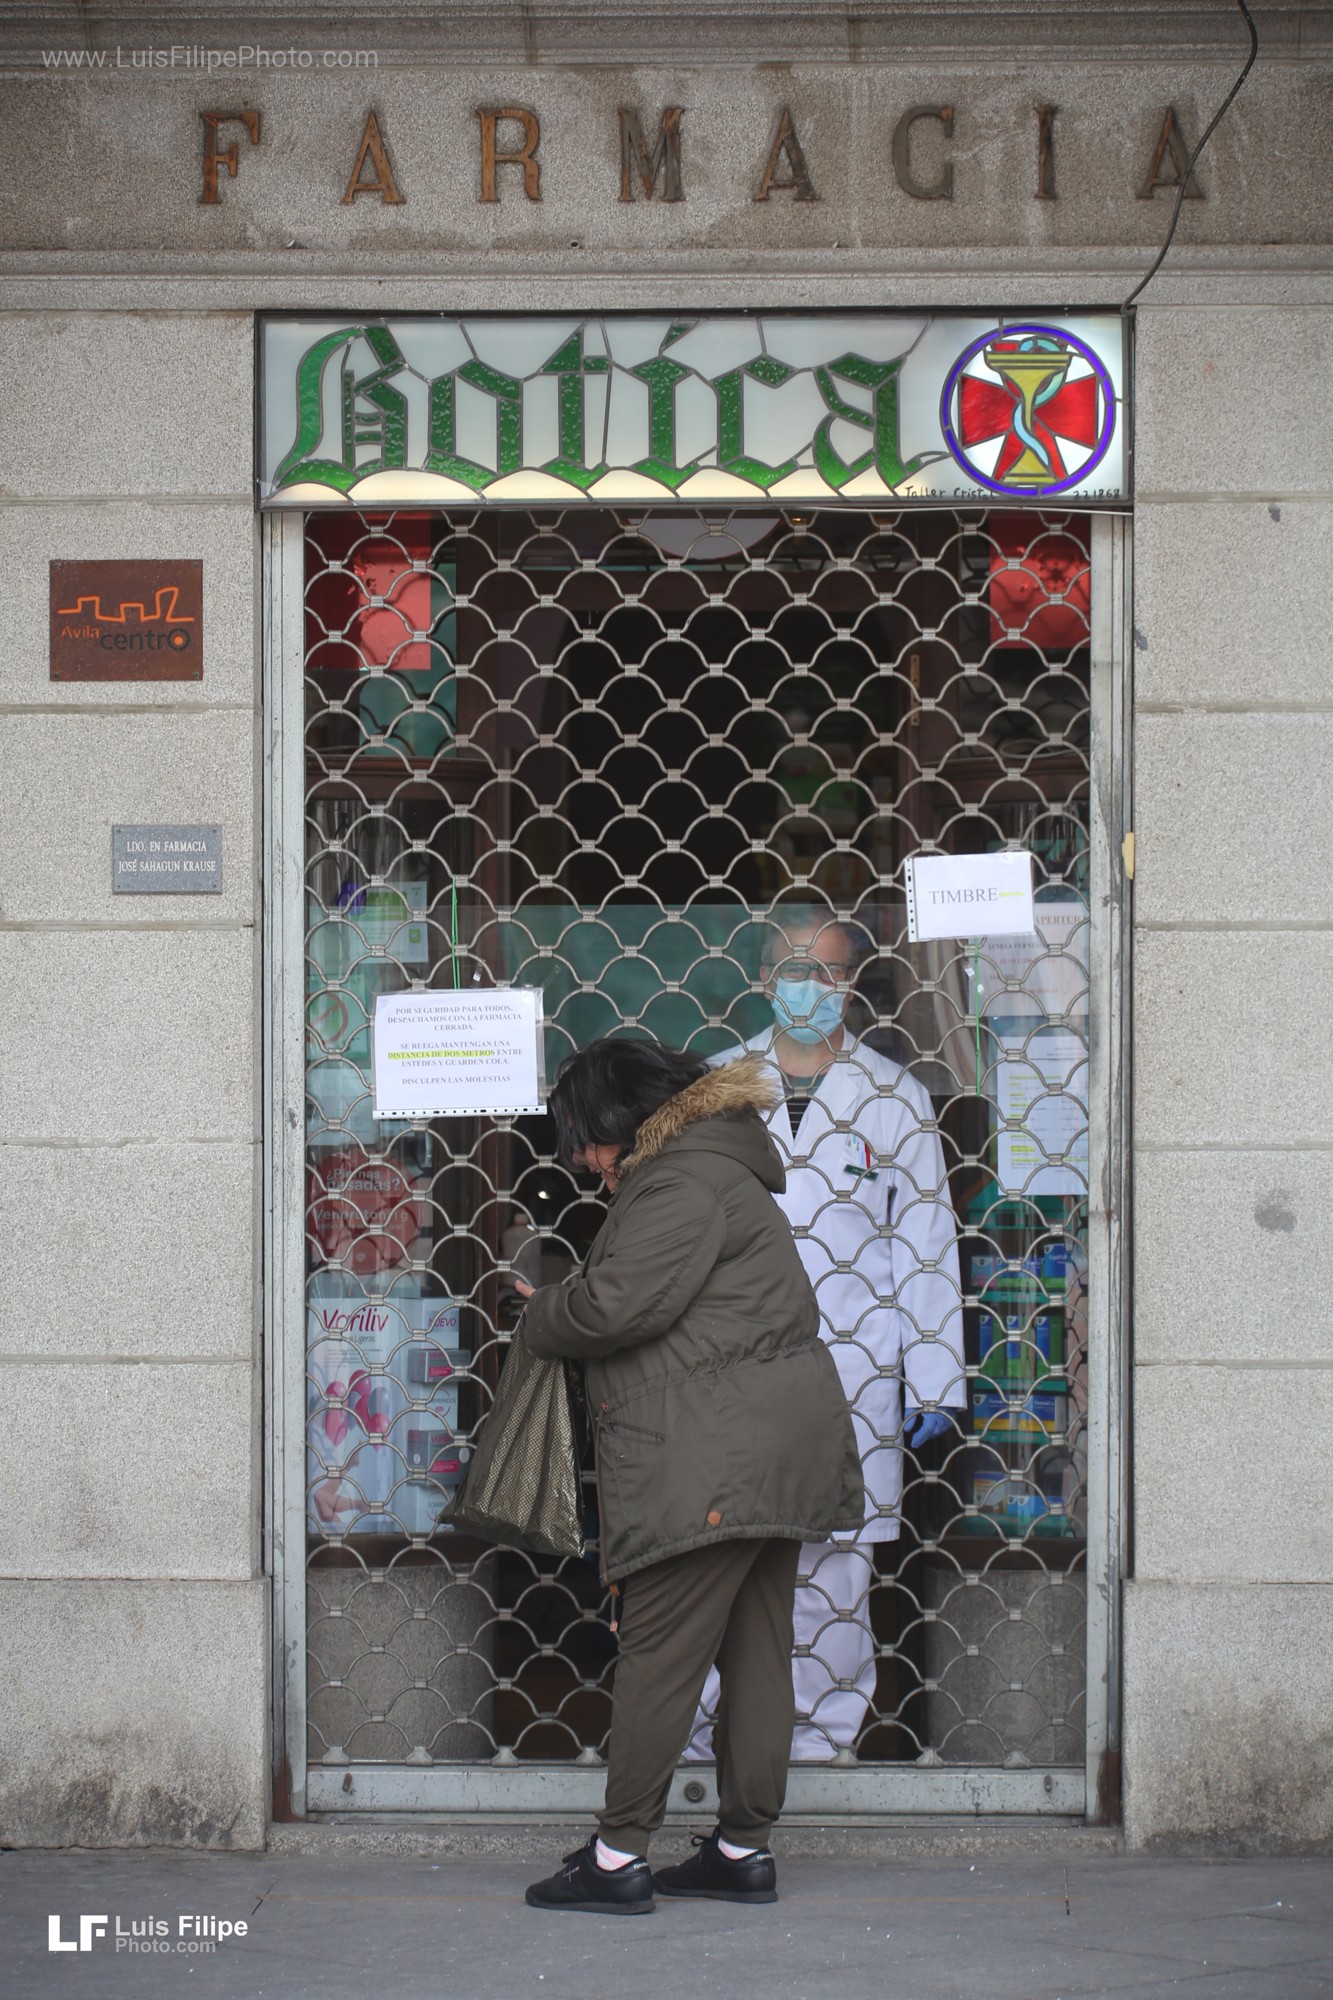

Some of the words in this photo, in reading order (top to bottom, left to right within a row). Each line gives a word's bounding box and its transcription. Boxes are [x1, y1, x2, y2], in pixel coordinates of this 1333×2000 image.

[198, 104, 1206, 206] FARMACIA
[126, 841, 146, 852] LDO.
[149, 841, 161, 852] EN
[164, 841, 207, 852] FARMACIA
[118, 858, 138, 874] JOSÉ
[139, 860, 181, 872] SAHAGUN
[183, 860, 216, 872] KRAUSE
[928, 887, 998, 905] TIMBRE
[413, 1006, 460, 1014] SEGURIDAD
[387, 1016, 447, 1024] DESPACHAMOS
[479, 1013, 522, 1021] FARMACIA
[441, 1041, 492, 1049] MANTENGAN
[462, 1049, 495, 1057] METROS
[497, 1048, 523, 1056] ENTRE
[445, 1058, 484, 1066] GUARDEN
[402, 1077, 446, 1085] DISCULPEN
[465, 1075, 511, 1083] MOLESTIAS
[322, 1308, 389, 1332] Variliv
